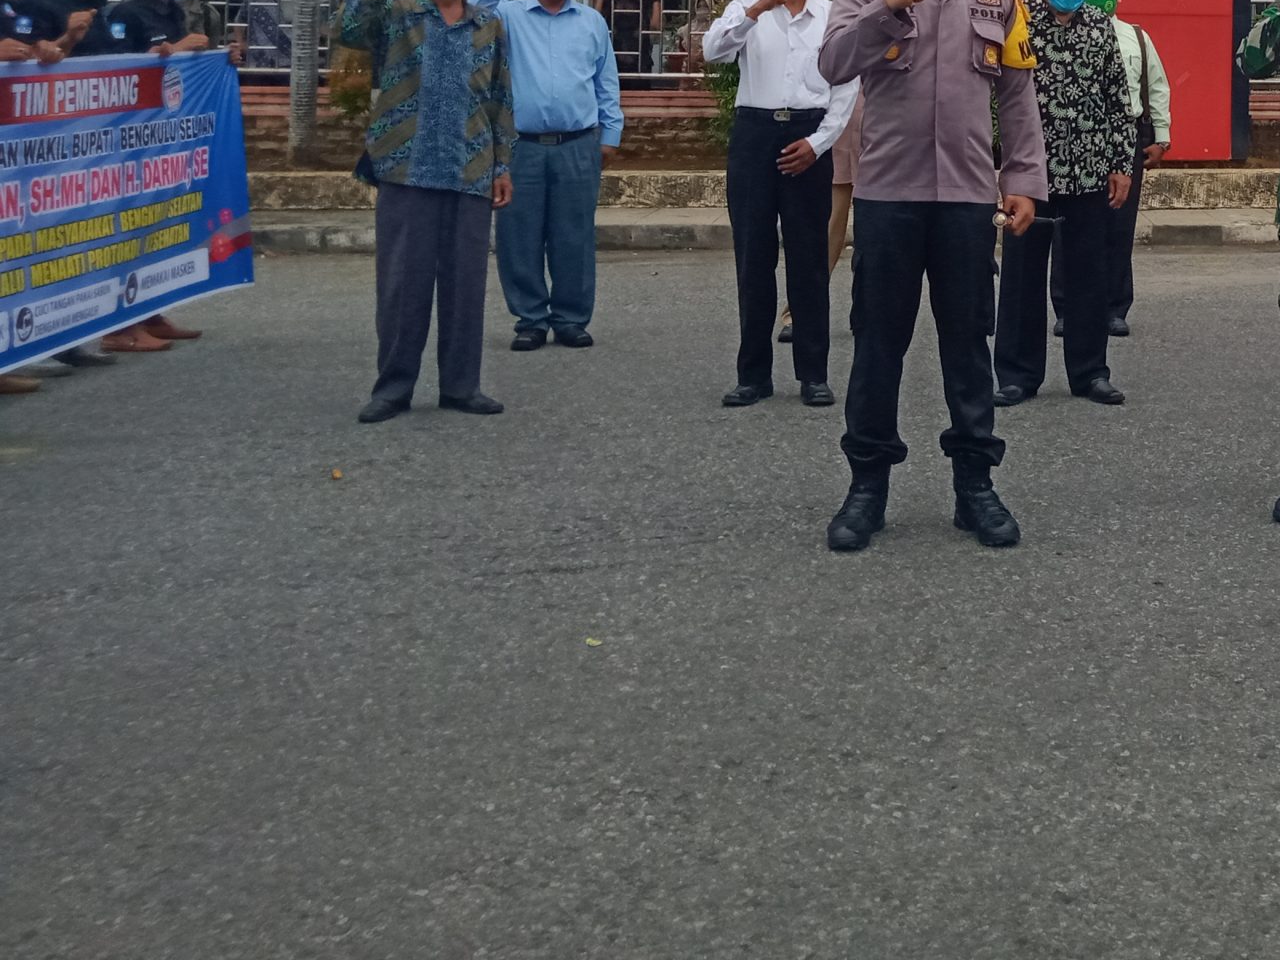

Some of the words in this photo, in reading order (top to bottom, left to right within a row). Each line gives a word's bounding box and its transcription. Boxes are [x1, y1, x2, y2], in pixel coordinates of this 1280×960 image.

[11, 81, 49, 118] TIM
[54, 74, 139, 114] PEMENANG
[23, 134, 69, 165] WAKIL
[71, 127, 115, 159] BUPATI
[119, 119, 178, 152] BENGKULU
[30, 168, 88, 216] SH.MH
[89, 163, 122, 205] DAN
[123, 160, 141, 197] H.
[192, 145, 210, 180] SE
[35, 212, 115, 251] MASYARAKAT
